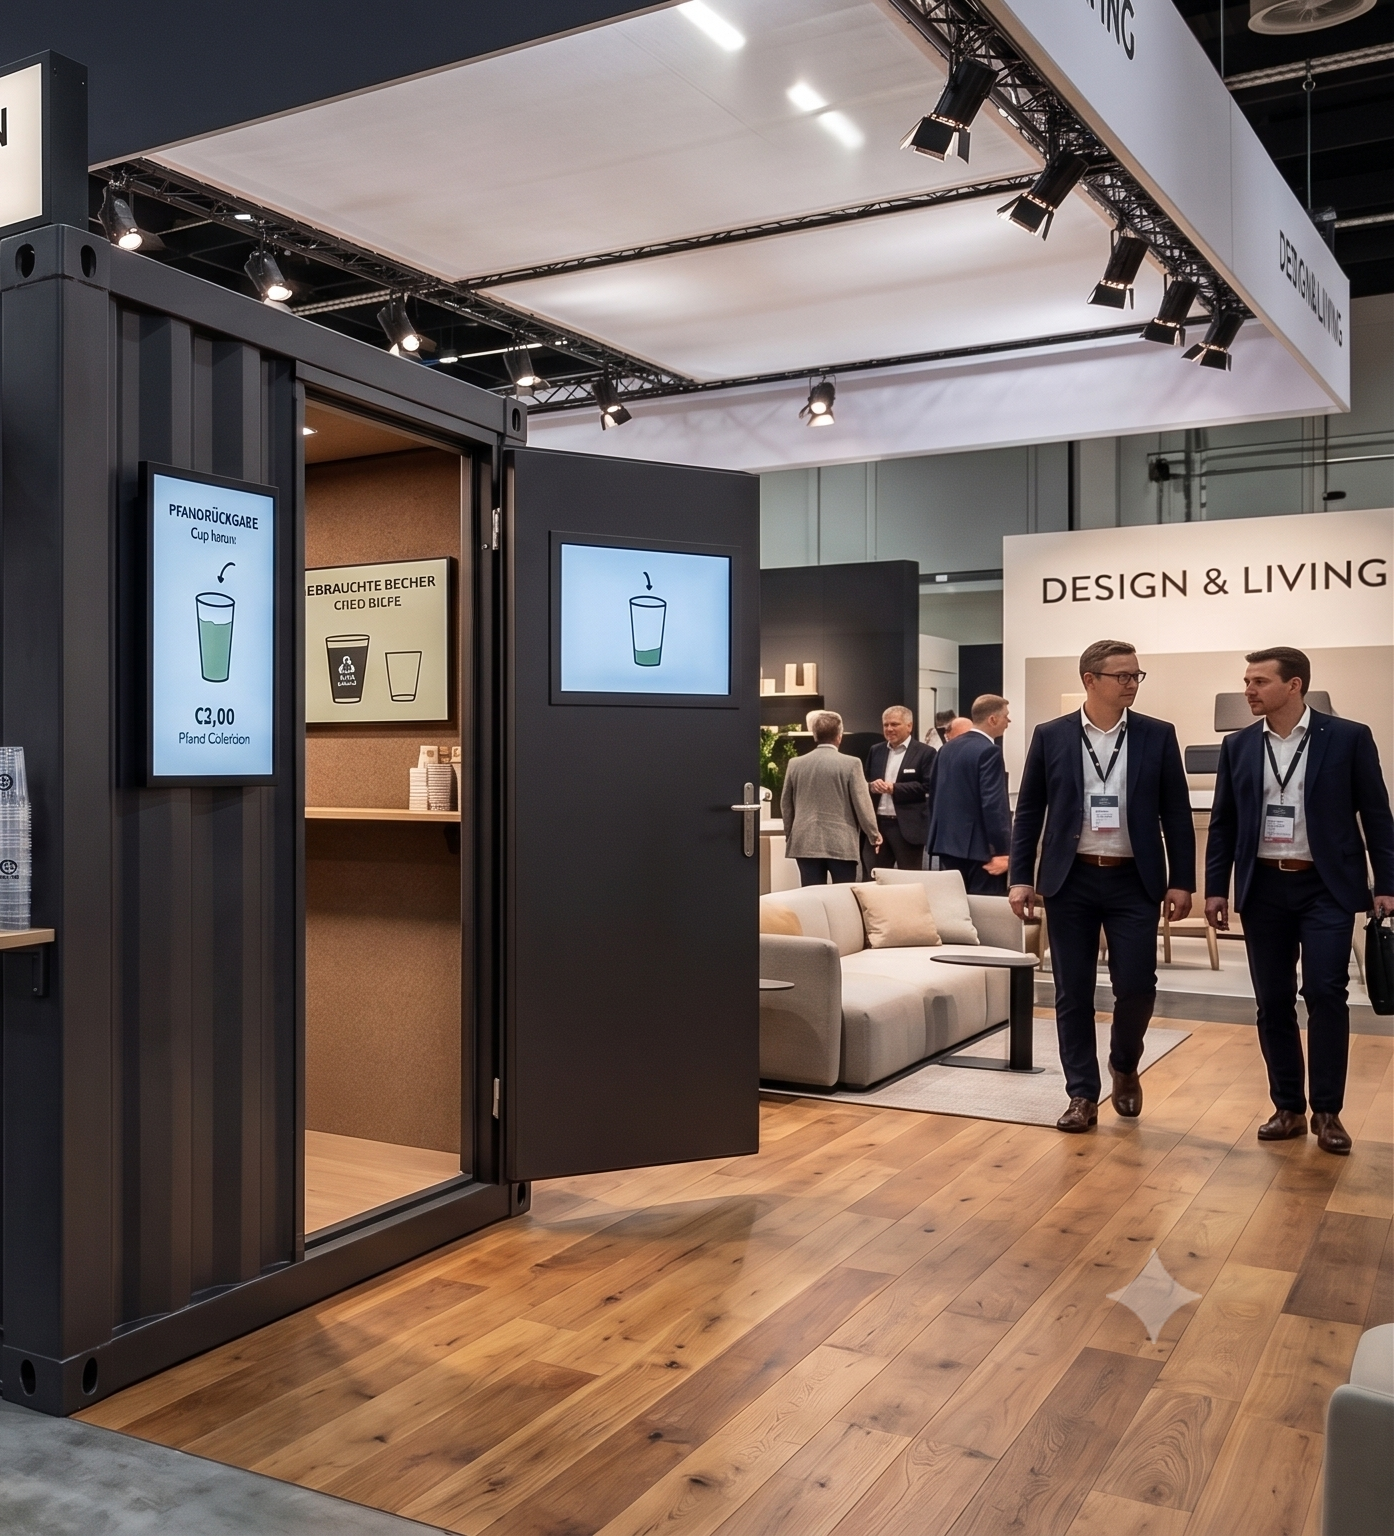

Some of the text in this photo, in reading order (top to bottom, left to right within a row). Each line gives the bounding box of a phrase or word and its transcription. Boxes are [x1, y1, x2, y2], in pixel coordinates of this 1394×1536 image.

[190, 526, 209, 544] Cup
[304, 575, 436, 597] EBRAUCHTE BECHER
[1042, 558, 1387, 604] DESIGN & LIVING
